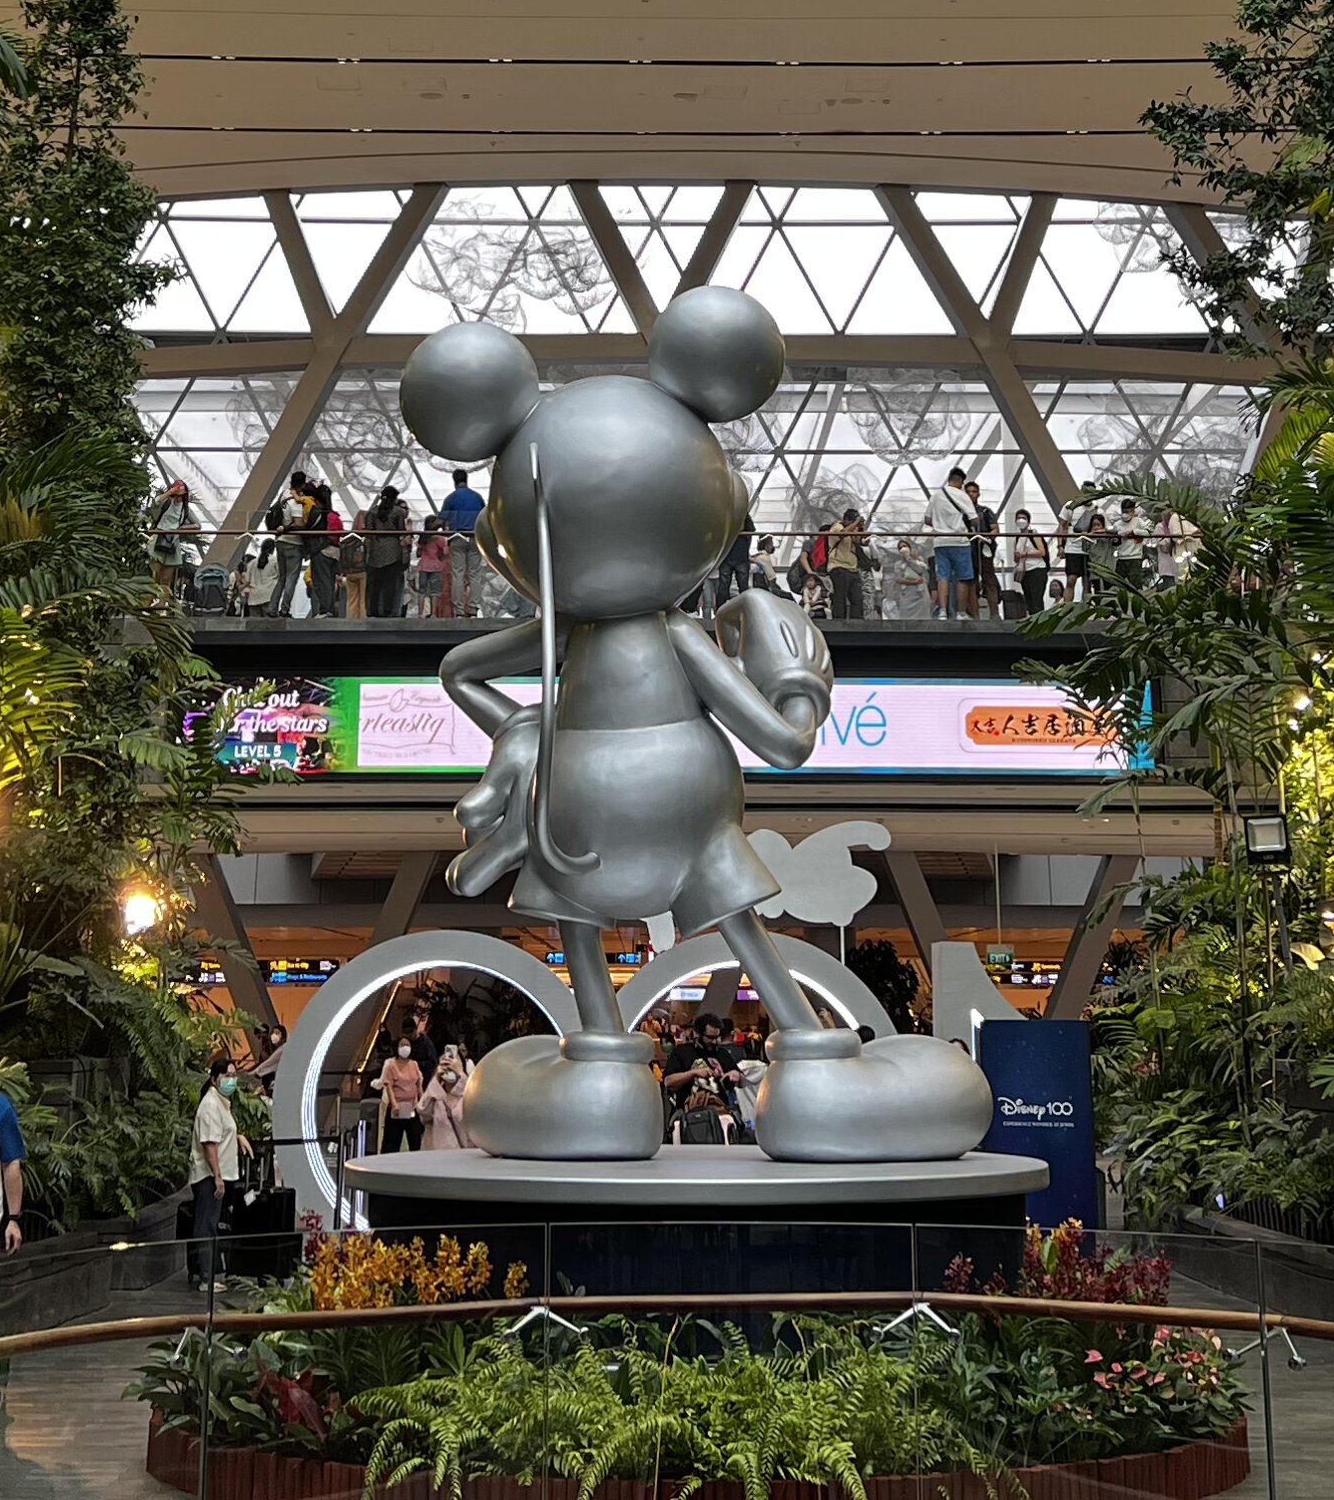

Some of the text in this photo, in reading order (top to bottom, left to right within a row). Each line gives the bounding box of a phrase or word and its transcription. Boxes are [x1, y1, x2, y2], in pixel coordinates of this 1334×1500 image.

[223, 685, 300, 708] Chi out
[248, 711, 279, 732] the
[279, 717, 328, 733] stars
[358, 713, 446, 744] rteastiq
[234, 745, 281, 757] LEVEL 5
[989, 953, 1006, 964] EXIT
[1046, 1101, 1073, 1116] 100
